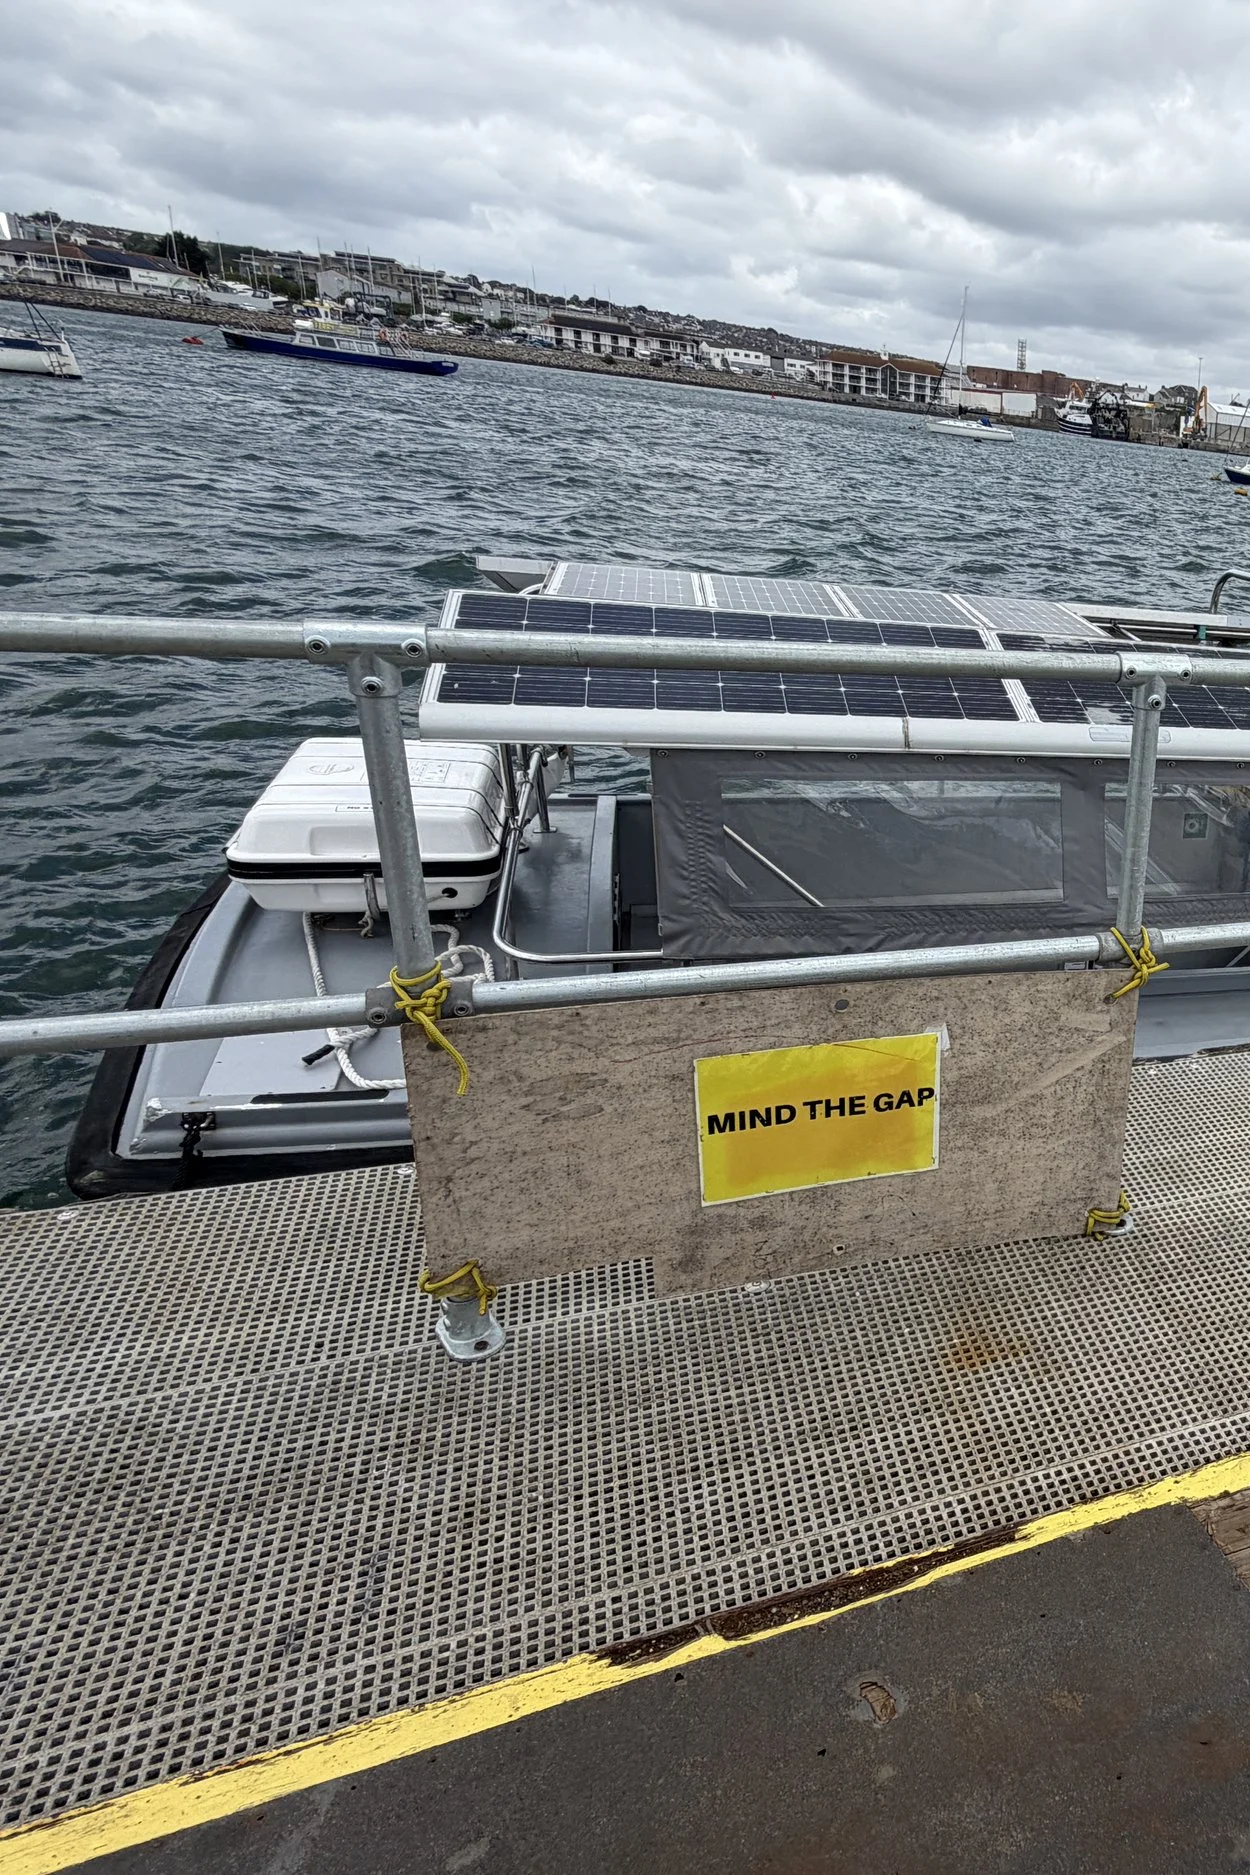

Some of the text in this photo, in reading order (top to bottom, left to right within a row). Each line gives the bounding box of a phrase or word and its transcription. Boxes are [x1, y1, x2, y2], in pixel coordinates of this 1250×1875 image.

[708, 1087, 935, 1135] MIND THE GAP
